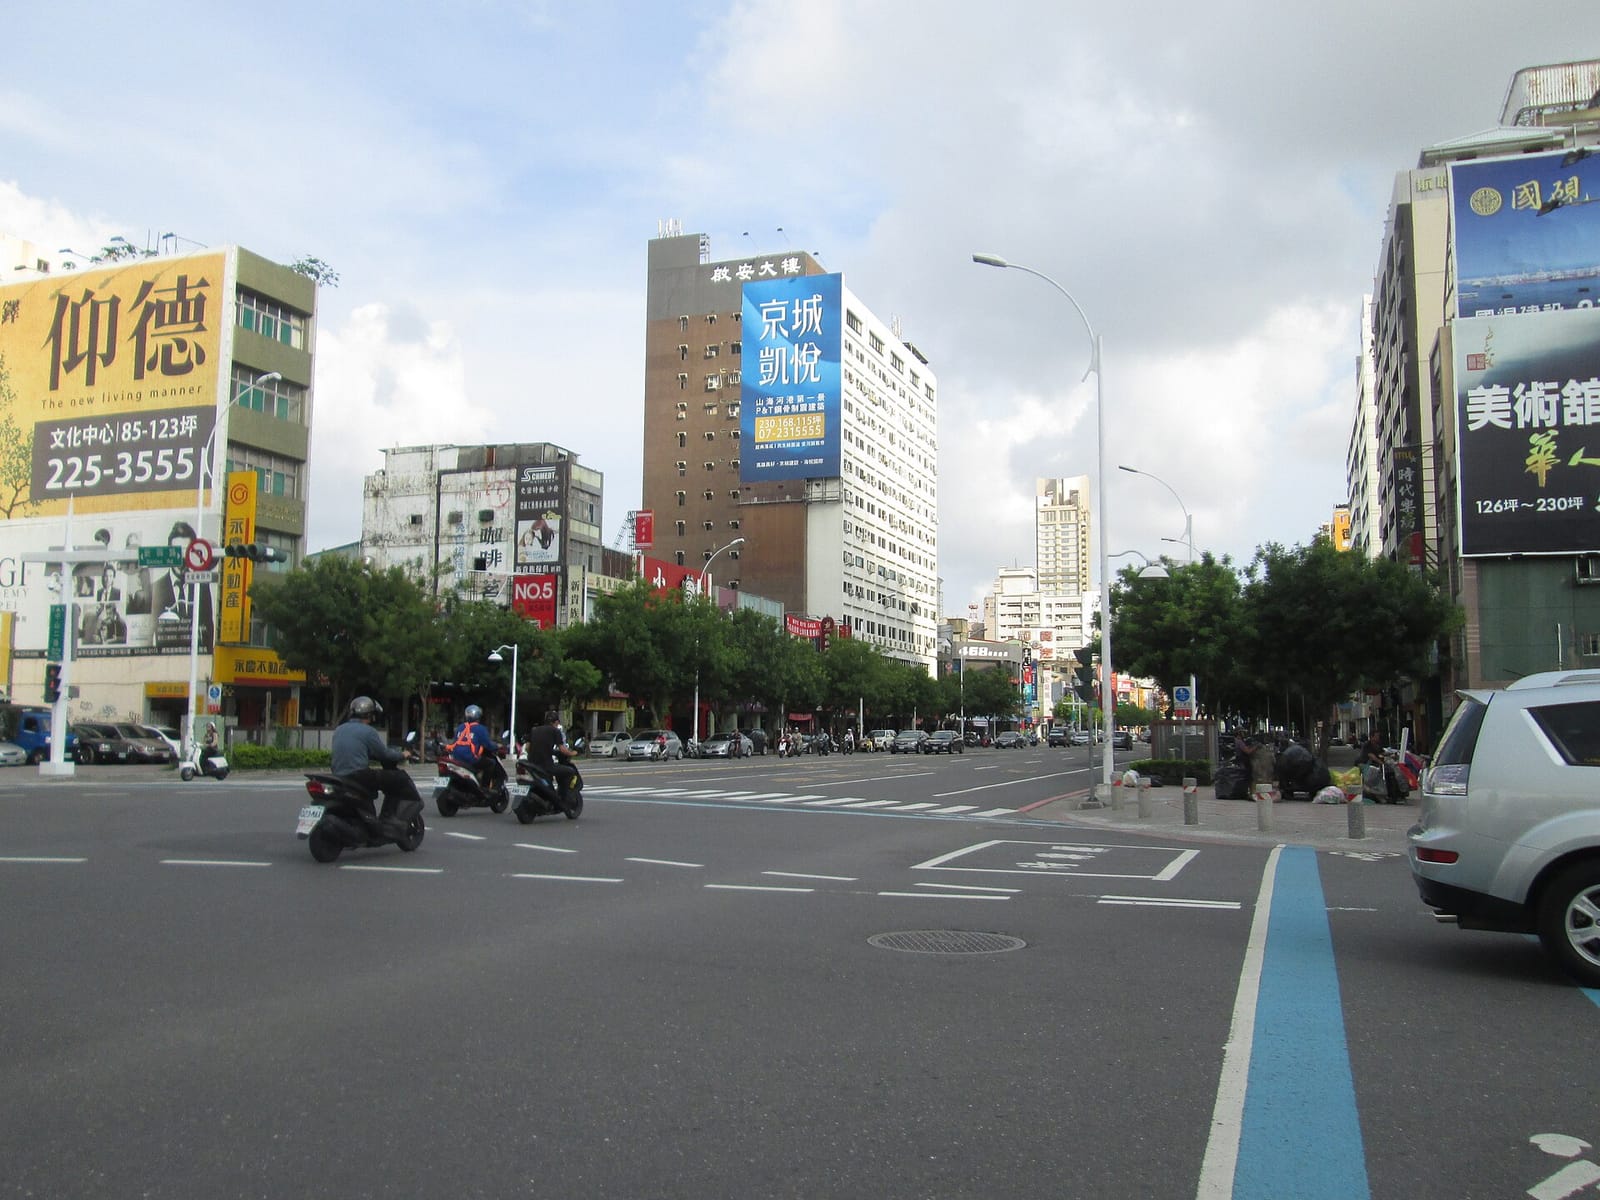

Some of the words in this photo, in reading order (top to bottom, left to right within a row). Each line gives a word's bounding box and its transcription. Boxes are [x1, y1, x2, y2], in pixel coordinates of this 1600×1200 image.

[759, 294, 823, 341] 京城
[41, 274, 210, 391] 仰德
[758, 342, 822, 386] 凱悅
[41, 400, 64, 410] The
[70, 397, 95, 406] new
[102, 390, 142, 404] living
[150, 385, 203, 397] manner
[50, 422, 114, 449] 文化中心
[121, 415, 198, 441] 85-123坪
[758, 425, 821, 439] 07-2315555
[759, 415, 822, 429] 230.168.115坪
[45, 447, 194, 489] 225-3555
[515, 582, 553, 600] NO.5
[234, 659, 288, 675] 永慶不動產
